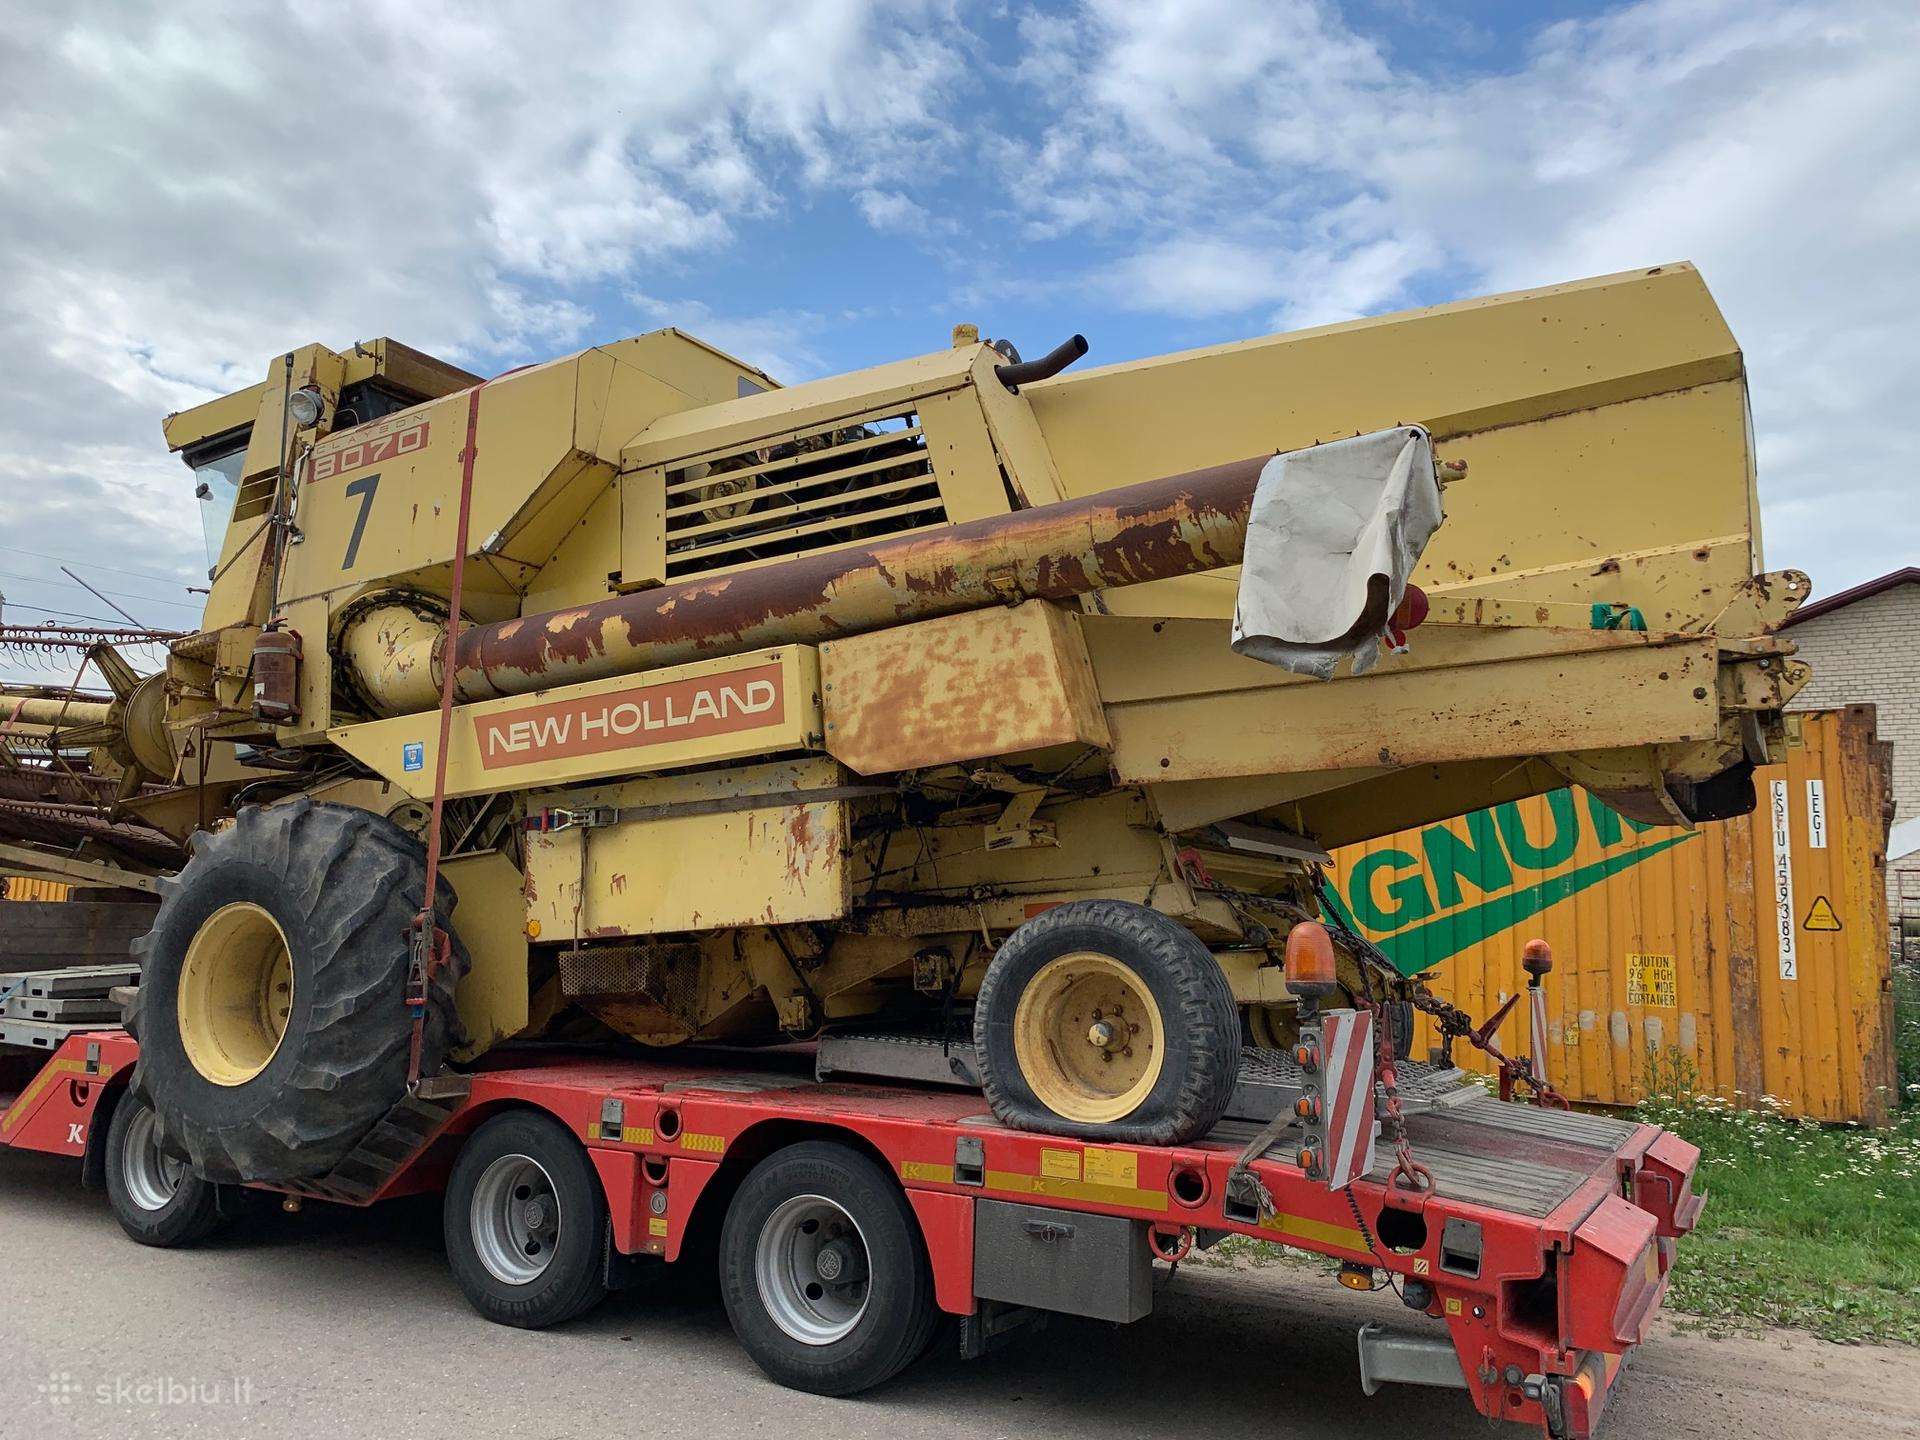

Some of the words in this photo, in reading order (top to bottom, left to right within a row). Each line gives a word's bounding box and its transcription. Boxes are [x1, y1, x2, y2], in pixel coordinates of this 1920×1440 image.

[313, 425, 423, 481] 8070
[342, 473, 382, 571] 7
[488, 714, 572, 756] NEW
[582, 679, 777, 741] HOLLAND
[1320, 784, 1655, 944] GNU
[1655, 981, 1675, 993] WIDE
[66, 1123, 84, 1144] K
